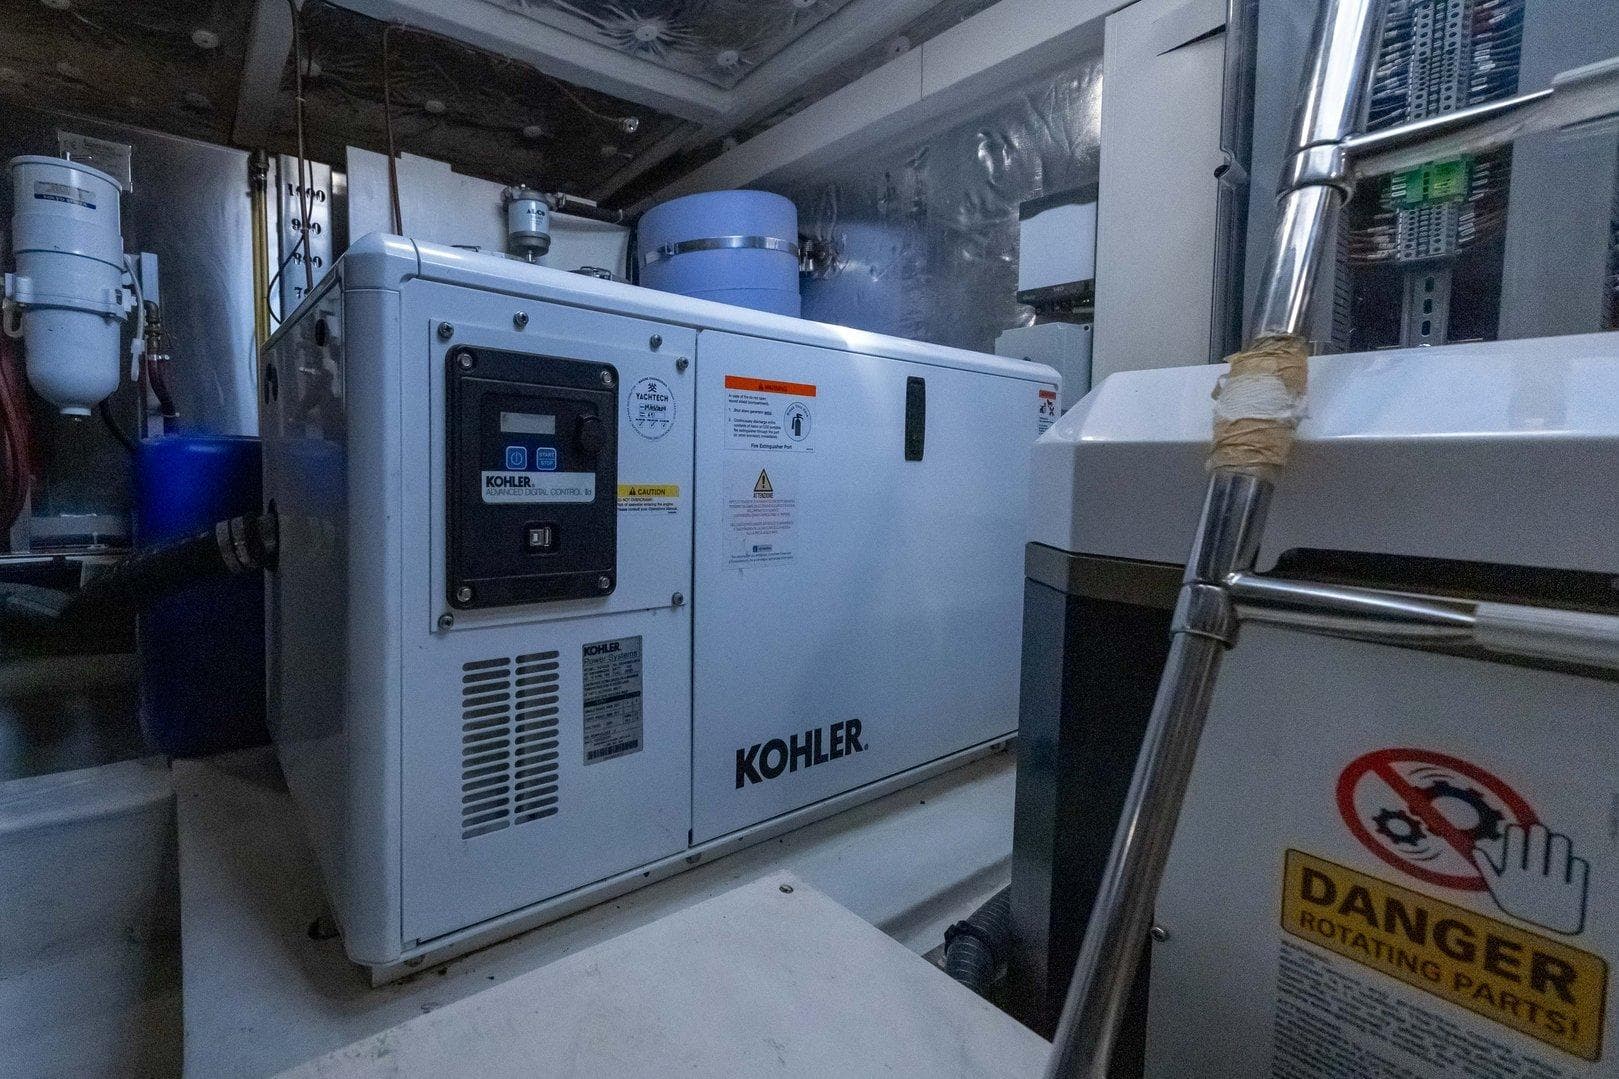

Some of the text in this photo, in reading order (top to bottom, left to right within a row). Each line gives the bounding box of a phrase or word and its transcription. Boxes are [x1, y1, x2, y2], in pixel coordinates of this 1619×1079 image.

[293, 252, 322, 268] 80
[635, 392, 669, 402] YACHTECH
[486, 488, 524, 496] ADVANCED
[551, 488, 583, 496] CONTROL
[583, 642, 620, 656] KOHLER
[608, 650, 638, 662] Systems
[735, 719, 863, 790] KOHLER
[1300, 866, 1579, 1005] DANGER
[1300, 910, 1442, 985] ROTATING
[1452, 971, 1581, 1042] PARTS!
